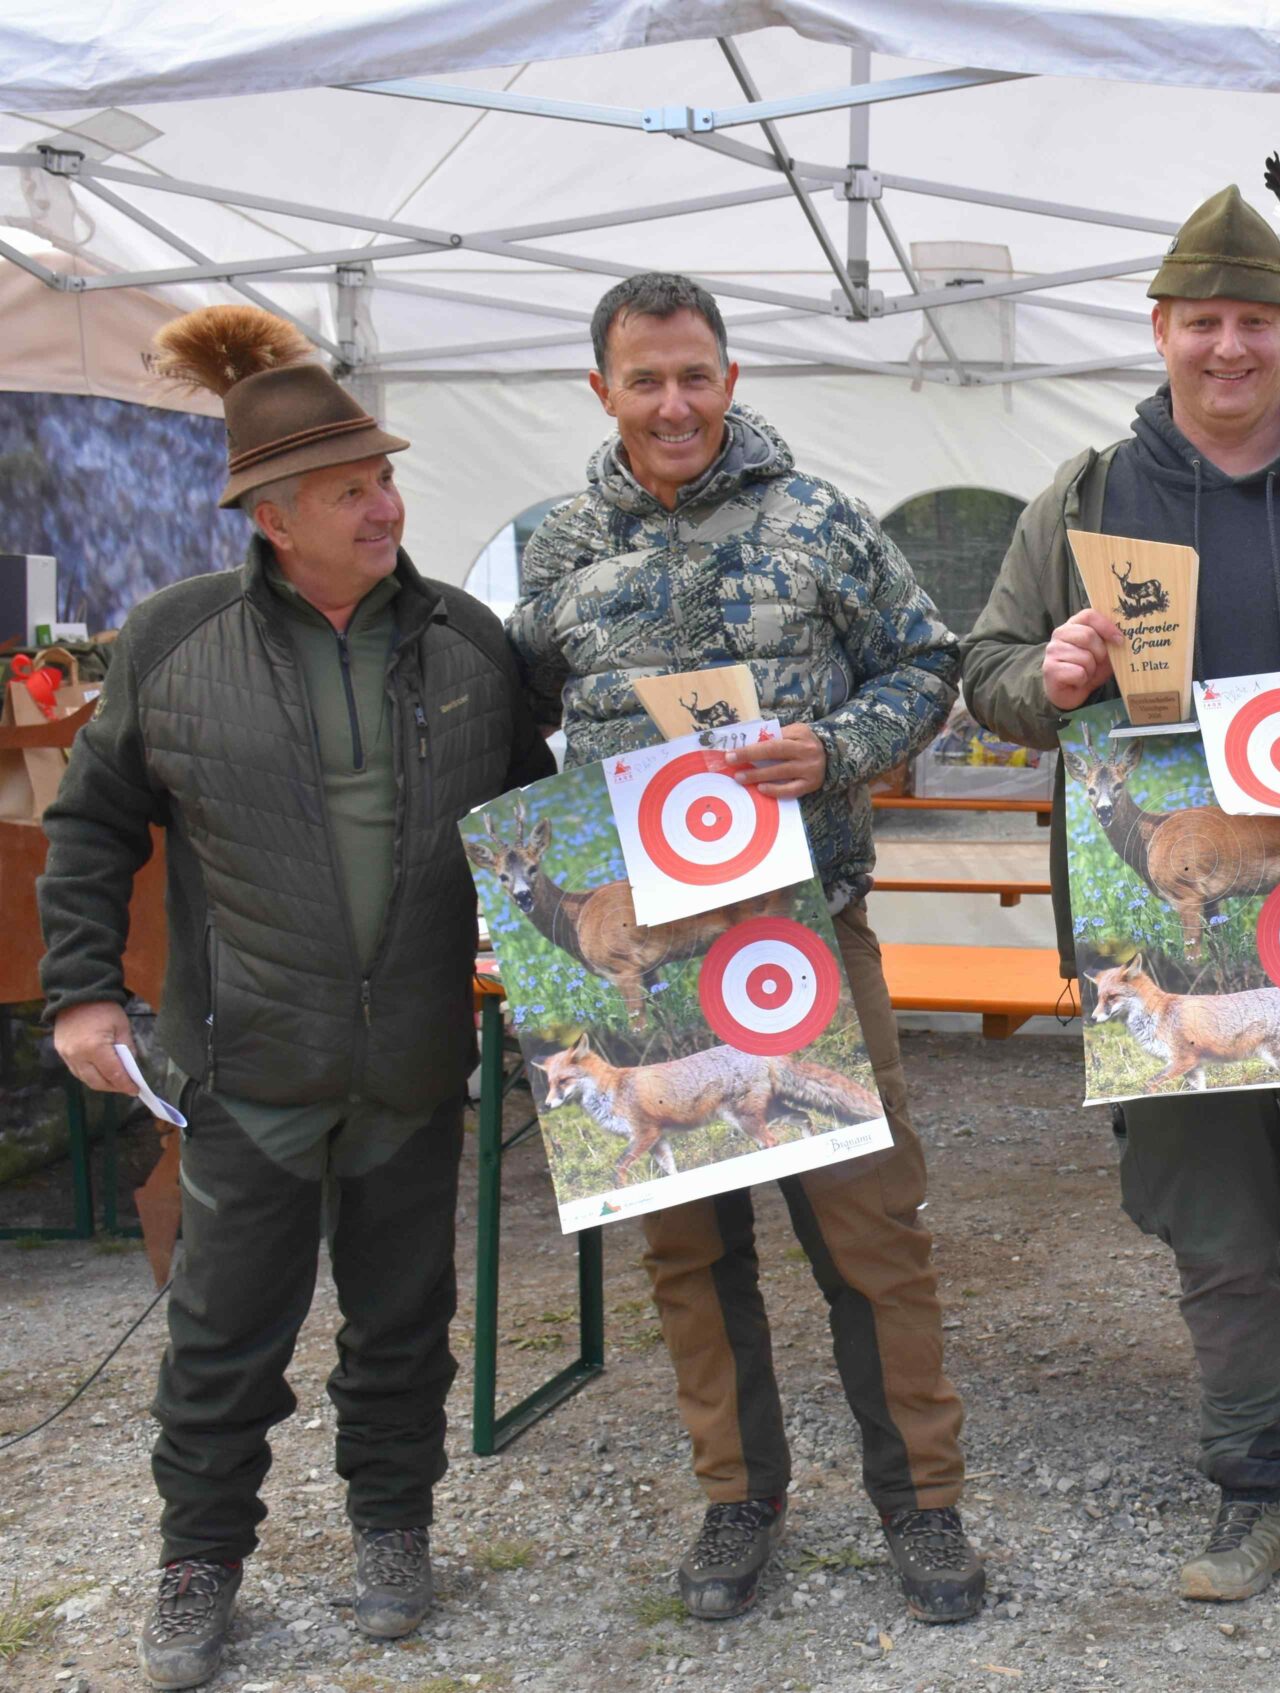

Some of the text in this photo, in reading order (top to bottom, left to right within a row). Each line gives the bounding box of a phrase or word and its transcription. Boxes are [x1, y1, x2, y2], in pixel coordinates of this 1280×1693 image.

[1115, 621, 1180, 640] agdrevier
[1131, 637, 1171, 655] Graun
[1130, 660, 1169, 672] 1. Platz
